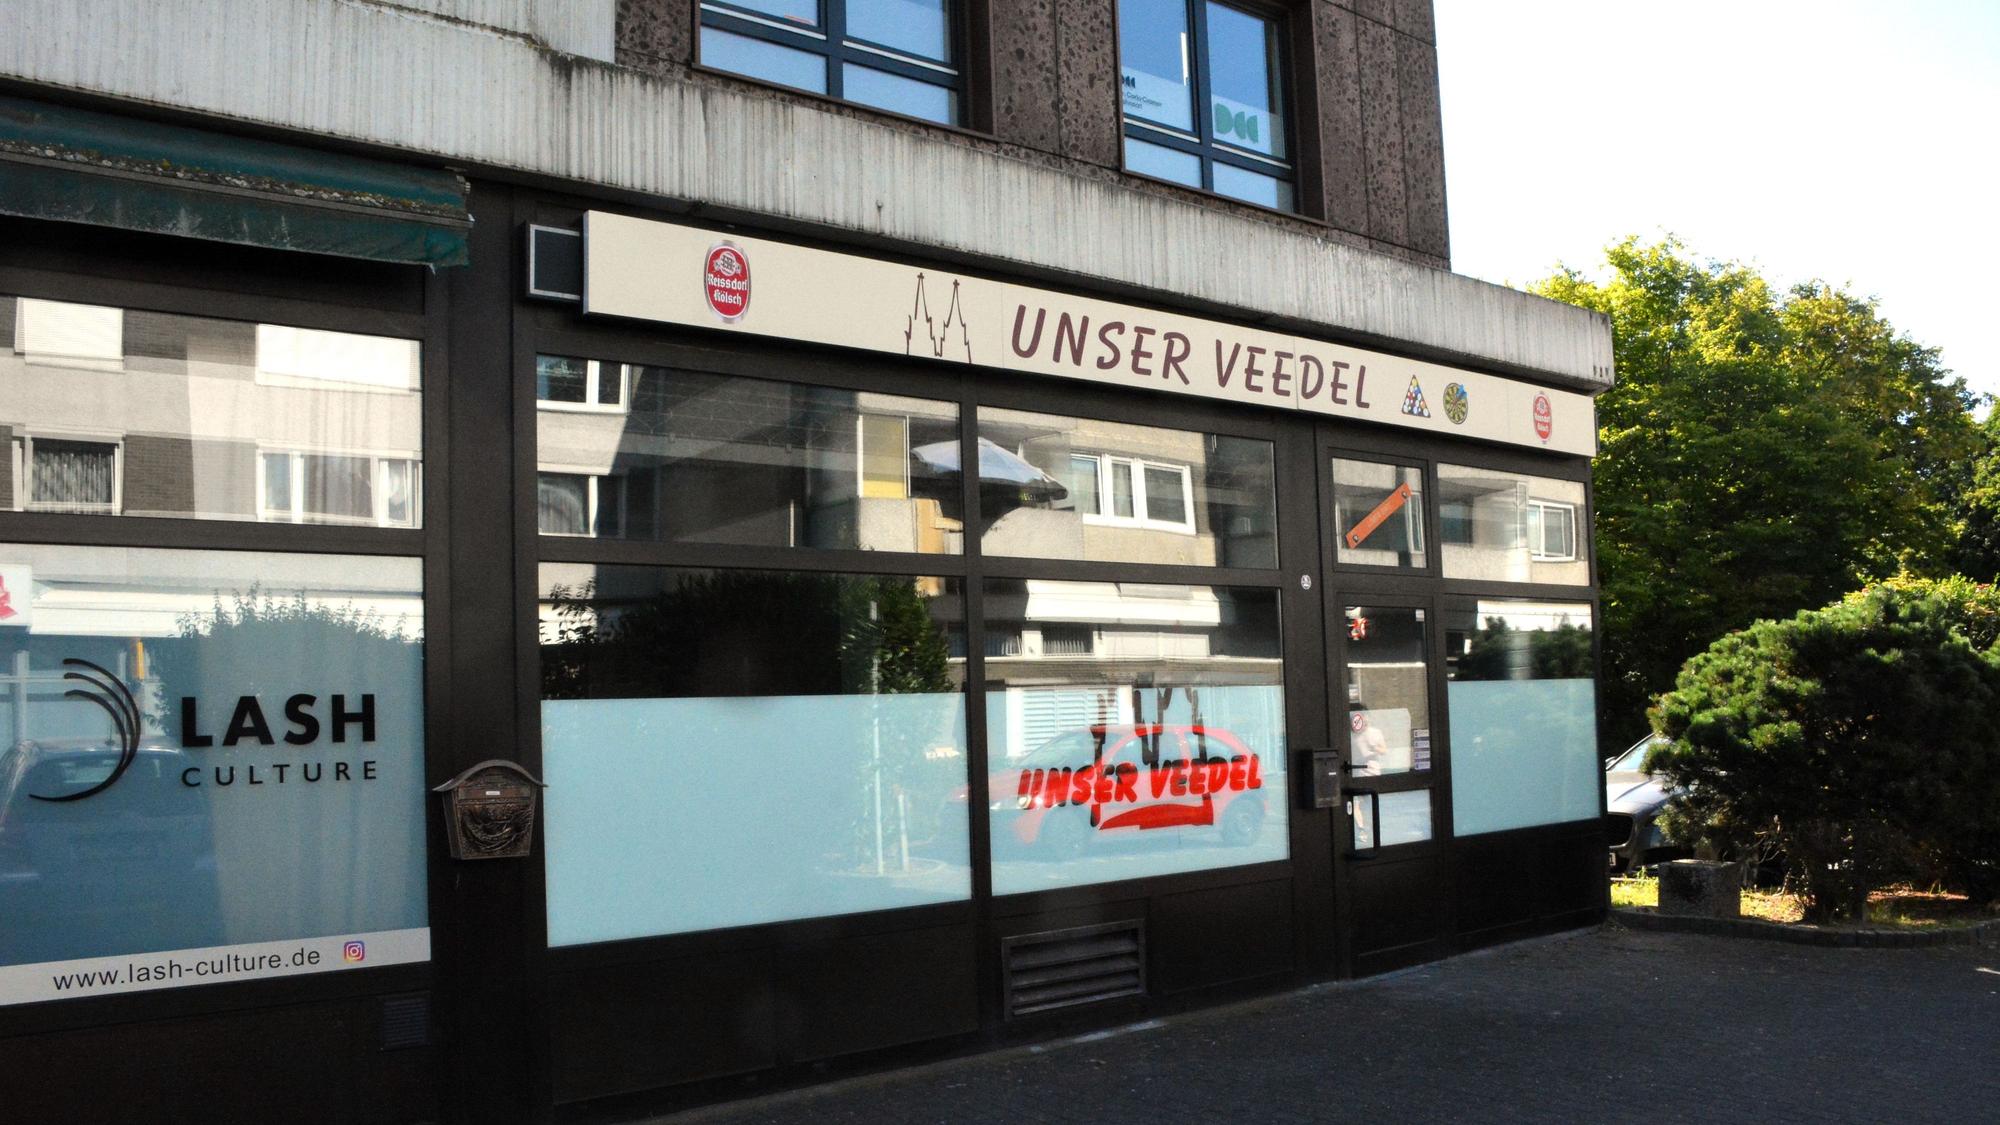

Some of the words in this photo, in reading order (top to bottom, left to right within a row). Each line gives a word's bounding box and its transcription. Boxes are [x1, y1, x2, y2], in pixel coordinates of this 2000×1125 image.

[708, 274, 747, 290] Reissdorf
[714, 290, 741, 306] Kölsch
[1011, 304, 1191, 386] UNSER
[1215, 338, 1371, 409] VEEDEL
[181, 693, 376, 748] LASH
[181, 760, 377, 788] CULTURE
[1017, 761, 1138, 810] UNSER
[1150, 753, 1262, 799] VEEDEL
[53, 947, 321, 991] www.lash-culture.de
